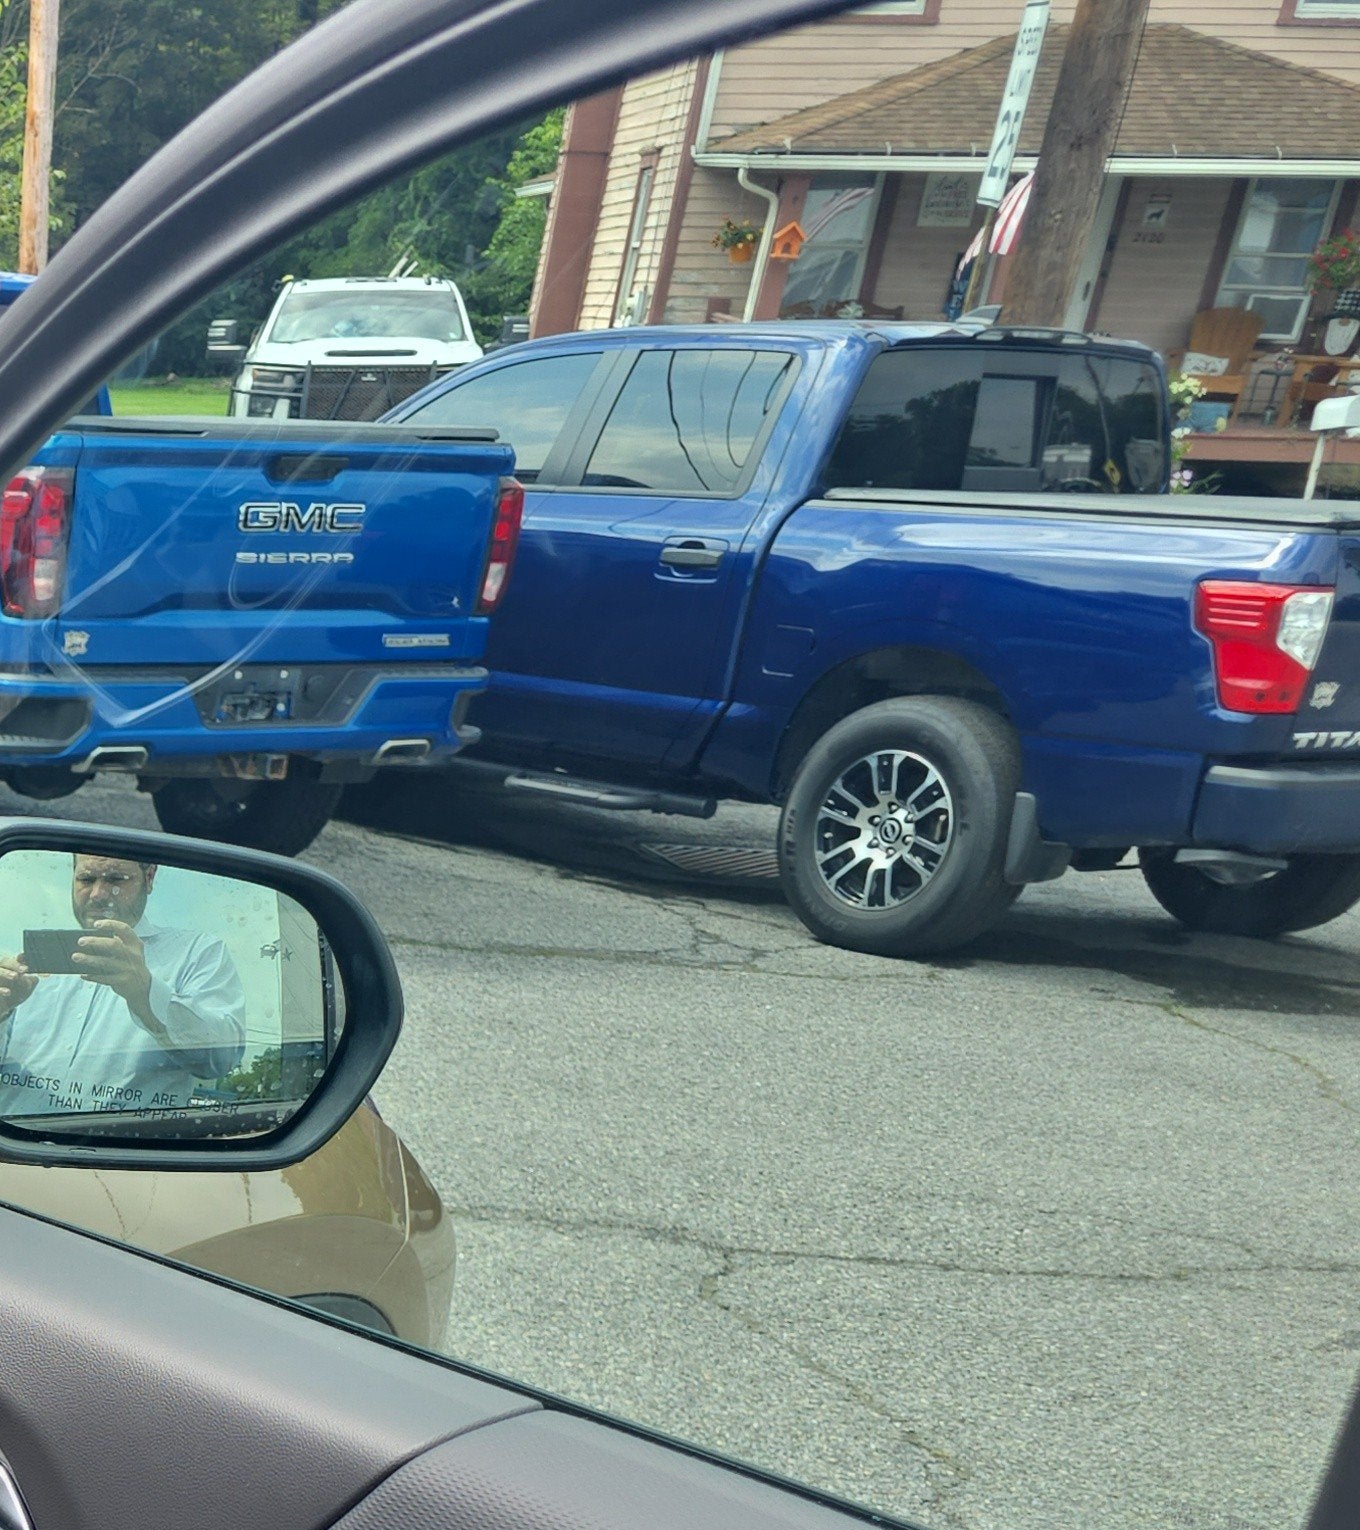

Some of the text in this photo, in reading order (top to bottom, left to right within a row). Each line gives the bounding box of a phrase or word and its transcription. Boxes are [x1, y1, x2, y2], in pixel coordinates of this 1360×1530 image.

[238, 501, 366, 533] GMC
[235, 552, 355, 564] SIERRA
[0, 1073, 240, 1115] OBJECTS IN MIRROR ARE COSER
[48, 1094, 83, 1110] THAN
[92, 1101, 126, 1115] THEY
